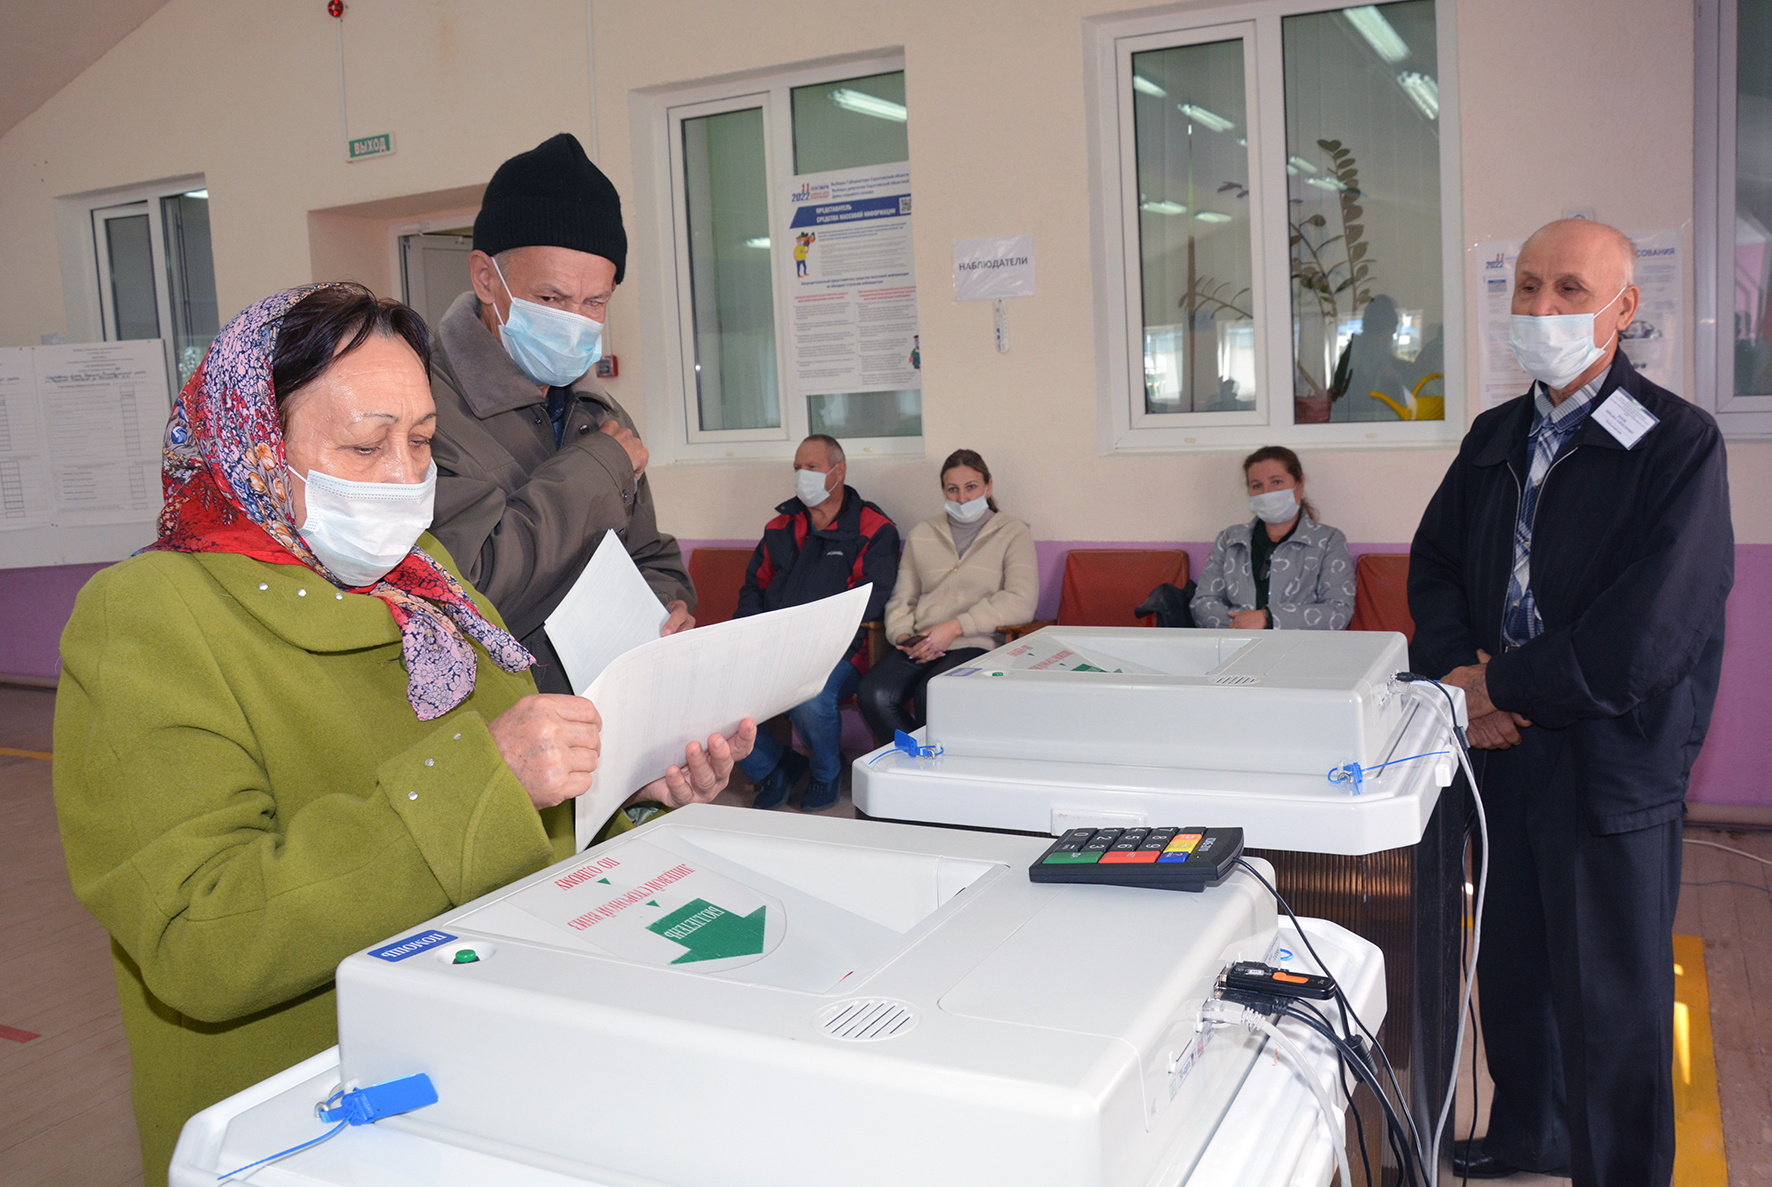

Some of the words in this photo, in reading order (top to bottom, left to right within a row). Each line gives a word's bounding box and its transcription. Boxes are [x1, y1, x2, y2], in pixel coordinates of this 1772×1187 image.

[354, 137, 387, 155] ВЫХОД
[801, 183, 809, 193] 11
[791, 192, 810, 202] 2022
[816, 204, 852, 214] ПРЕДСТАВИТЕЛЬ
[816, 214, 839, 223] СРЕДСТВА
[839, 211, 863, 220] МАССОВОЙ
[864, 208, 896, 217] ИНФОРМАЦИИ
[958, 257, 1029, 271] НАБЛЮДАТЕЛИ
[1485, 260, 1504, 269] 2022
[596, 856, 621, 869] ПО
[554, 864, 602, 891] ОДНОМУ
[644, 863, 696, 893] ЛИЦЕВОЙ
[598, 885, 654, 918] СТОРОНОЙ
[567, 907, 604, 931] ВНИЗ
[664, 905, 726, 940] БЮЛЛЕТЕНЬ
[380, 933, 447, 958] ПОМОЩЬ
